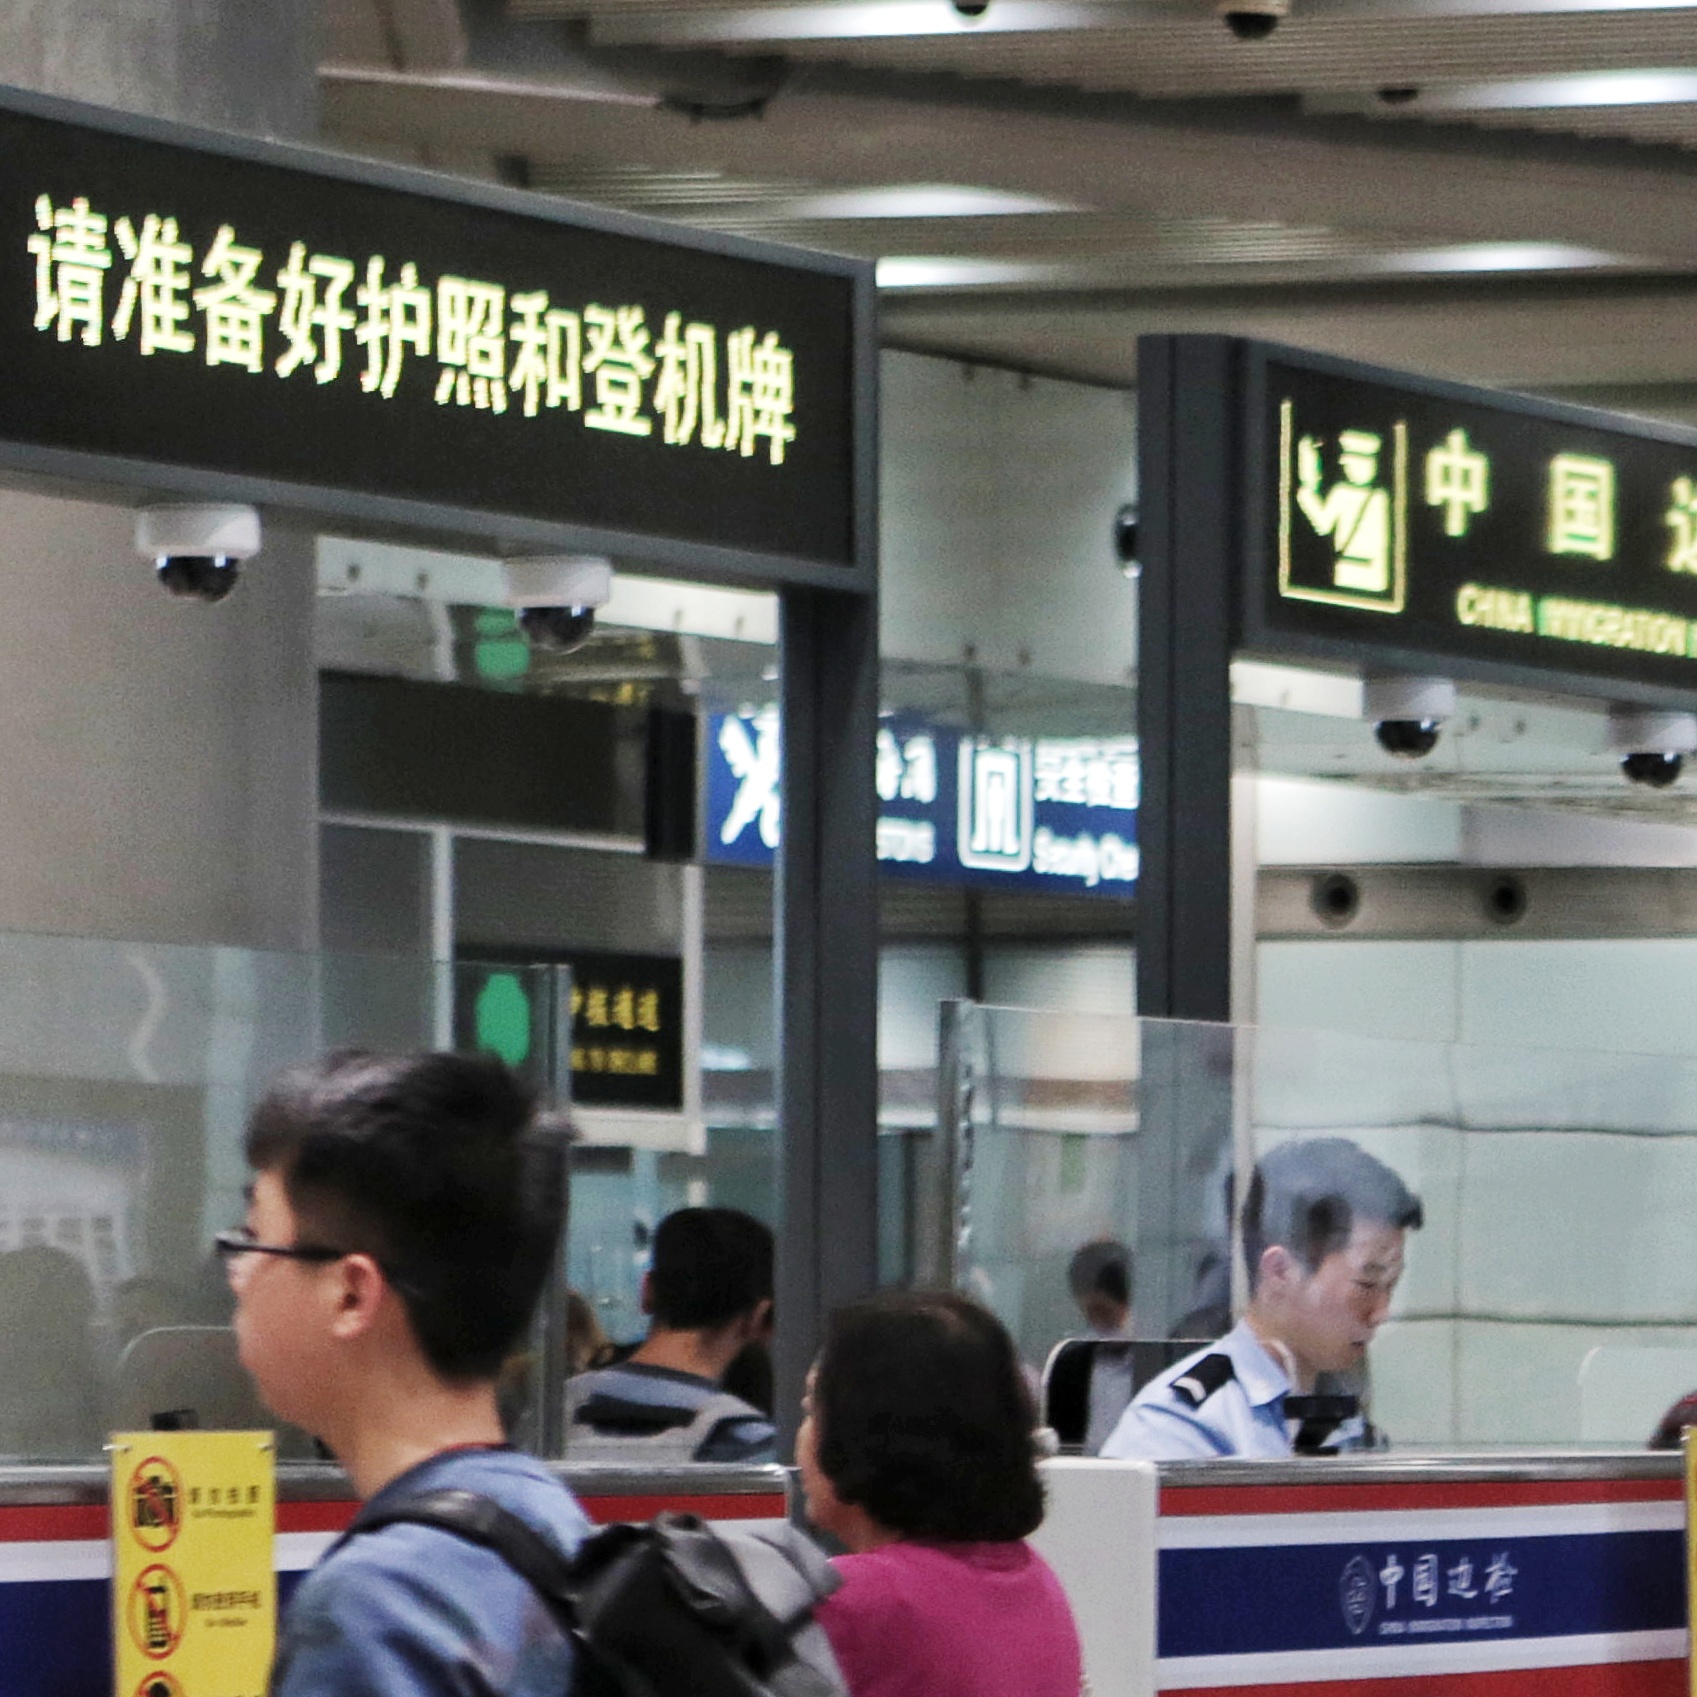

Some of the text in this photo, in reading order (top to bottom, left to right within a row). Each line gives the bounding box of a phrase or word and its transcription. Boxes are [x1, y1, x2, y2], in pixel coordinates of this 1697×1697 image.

[27, 194, 797, 465] 请准备好护照和登机牌
[1379, 1552, 1519, 1610] 中国边检
